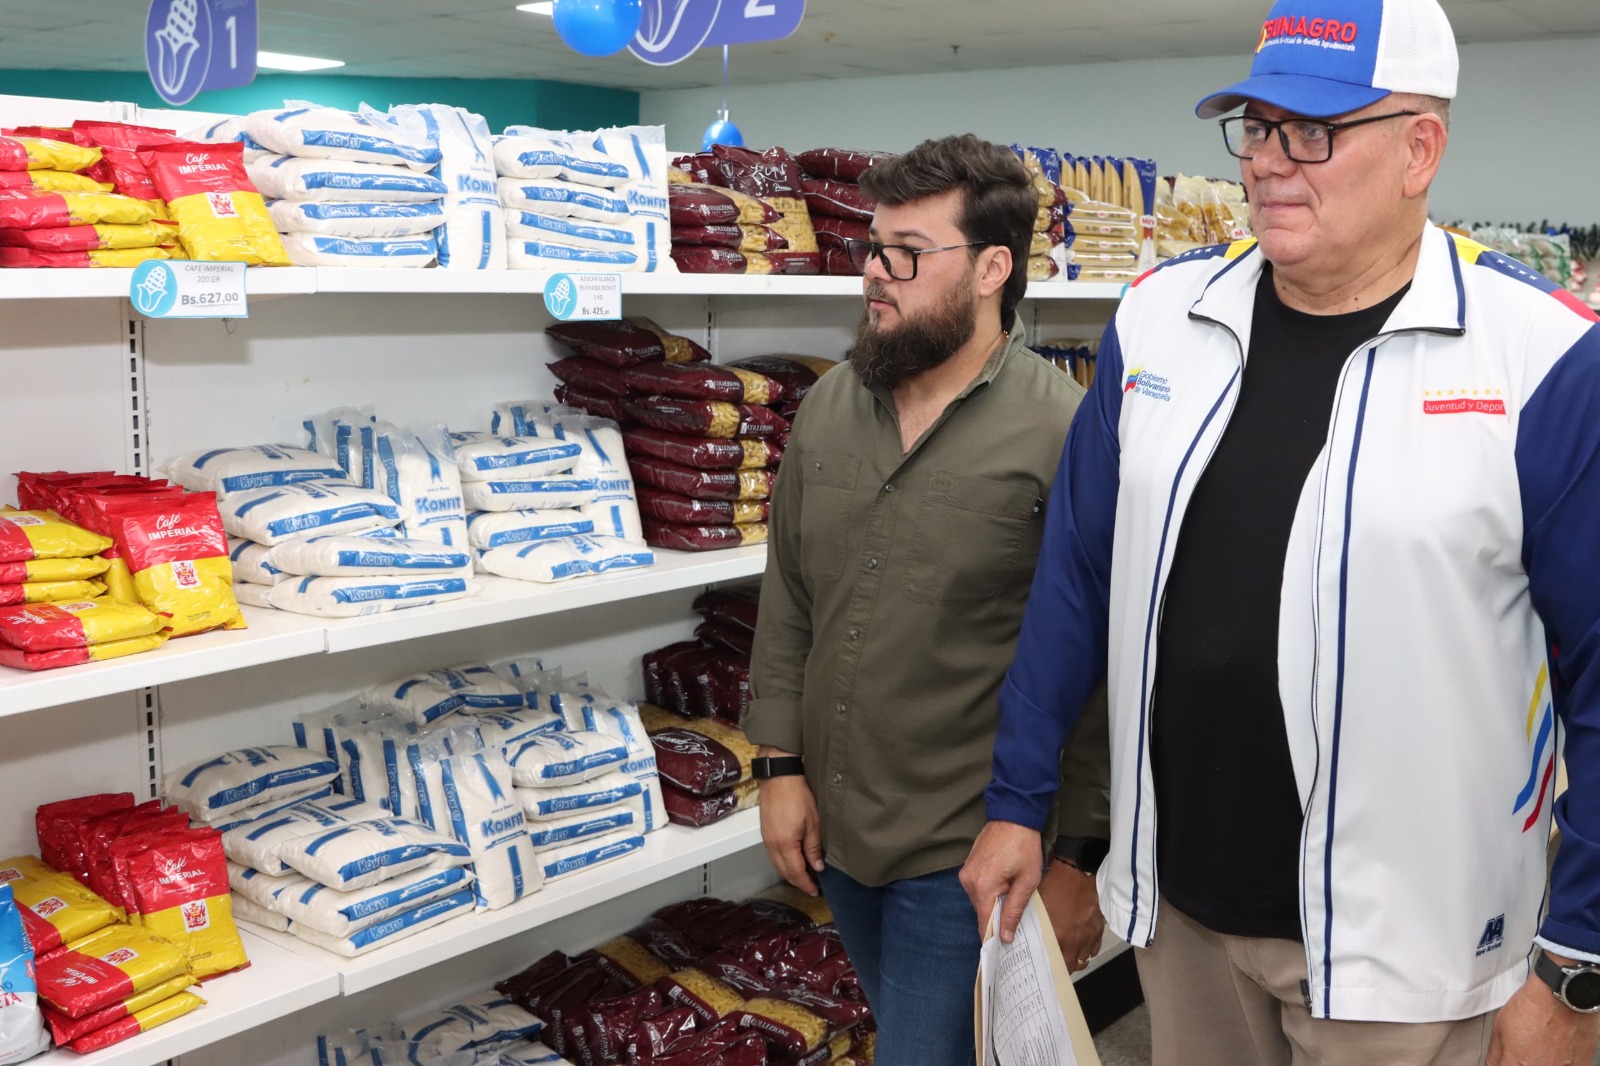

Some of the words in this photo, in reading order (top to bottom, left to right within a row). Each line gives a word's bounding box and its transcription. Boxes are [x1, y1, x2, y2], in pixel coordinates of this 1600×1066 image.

[225, 16, 238, 70] 1
[178, 163, 230, 176] IMPERIAL
[626, 189, 668, 210] KONFIT
[185, 264, 202, 273] CAFE
[203, 264, 234, 273] IMPERIAL
[197, 275, 210, 283] 200
[210, 275, 221, 283] GR
[181, 292, 239, 306] Bs.627,00
[582, 307, 592, 315] Bs.
[1137, 377, 1171, 393] Bolivariano
[1139, 370, 1168, 385] Gobierno
[1142, 387, 1171, 402] Venezuela
[1424, 401, 1466, 411] Juventud
[414, 496, 462, 514] KONFIT
[156, 512, 181, 530] Café
[148, 526, 198, 541] IMPERIAL
[360, 552, 394, 567] KONFIT
[350, 588, 386, 601] KONFIT
[619, 757, 656, 774] KONFIT
[444, 783, 462, 823] KONFIT
[481, 811, 524, 838] KONFIT
[164, 856, 187, 875] Café
[556, 857, 587, 873] KONFIT
[159, 868, 205, 885] IMPERIAL
[353, 897, 389, 918] KONFIT
[370, 918, 404, 939] KONFIT
[678, 991, 713, 1022] COLLEZIONE
[750, 1017, 792, 1038] COLLEZIONE
